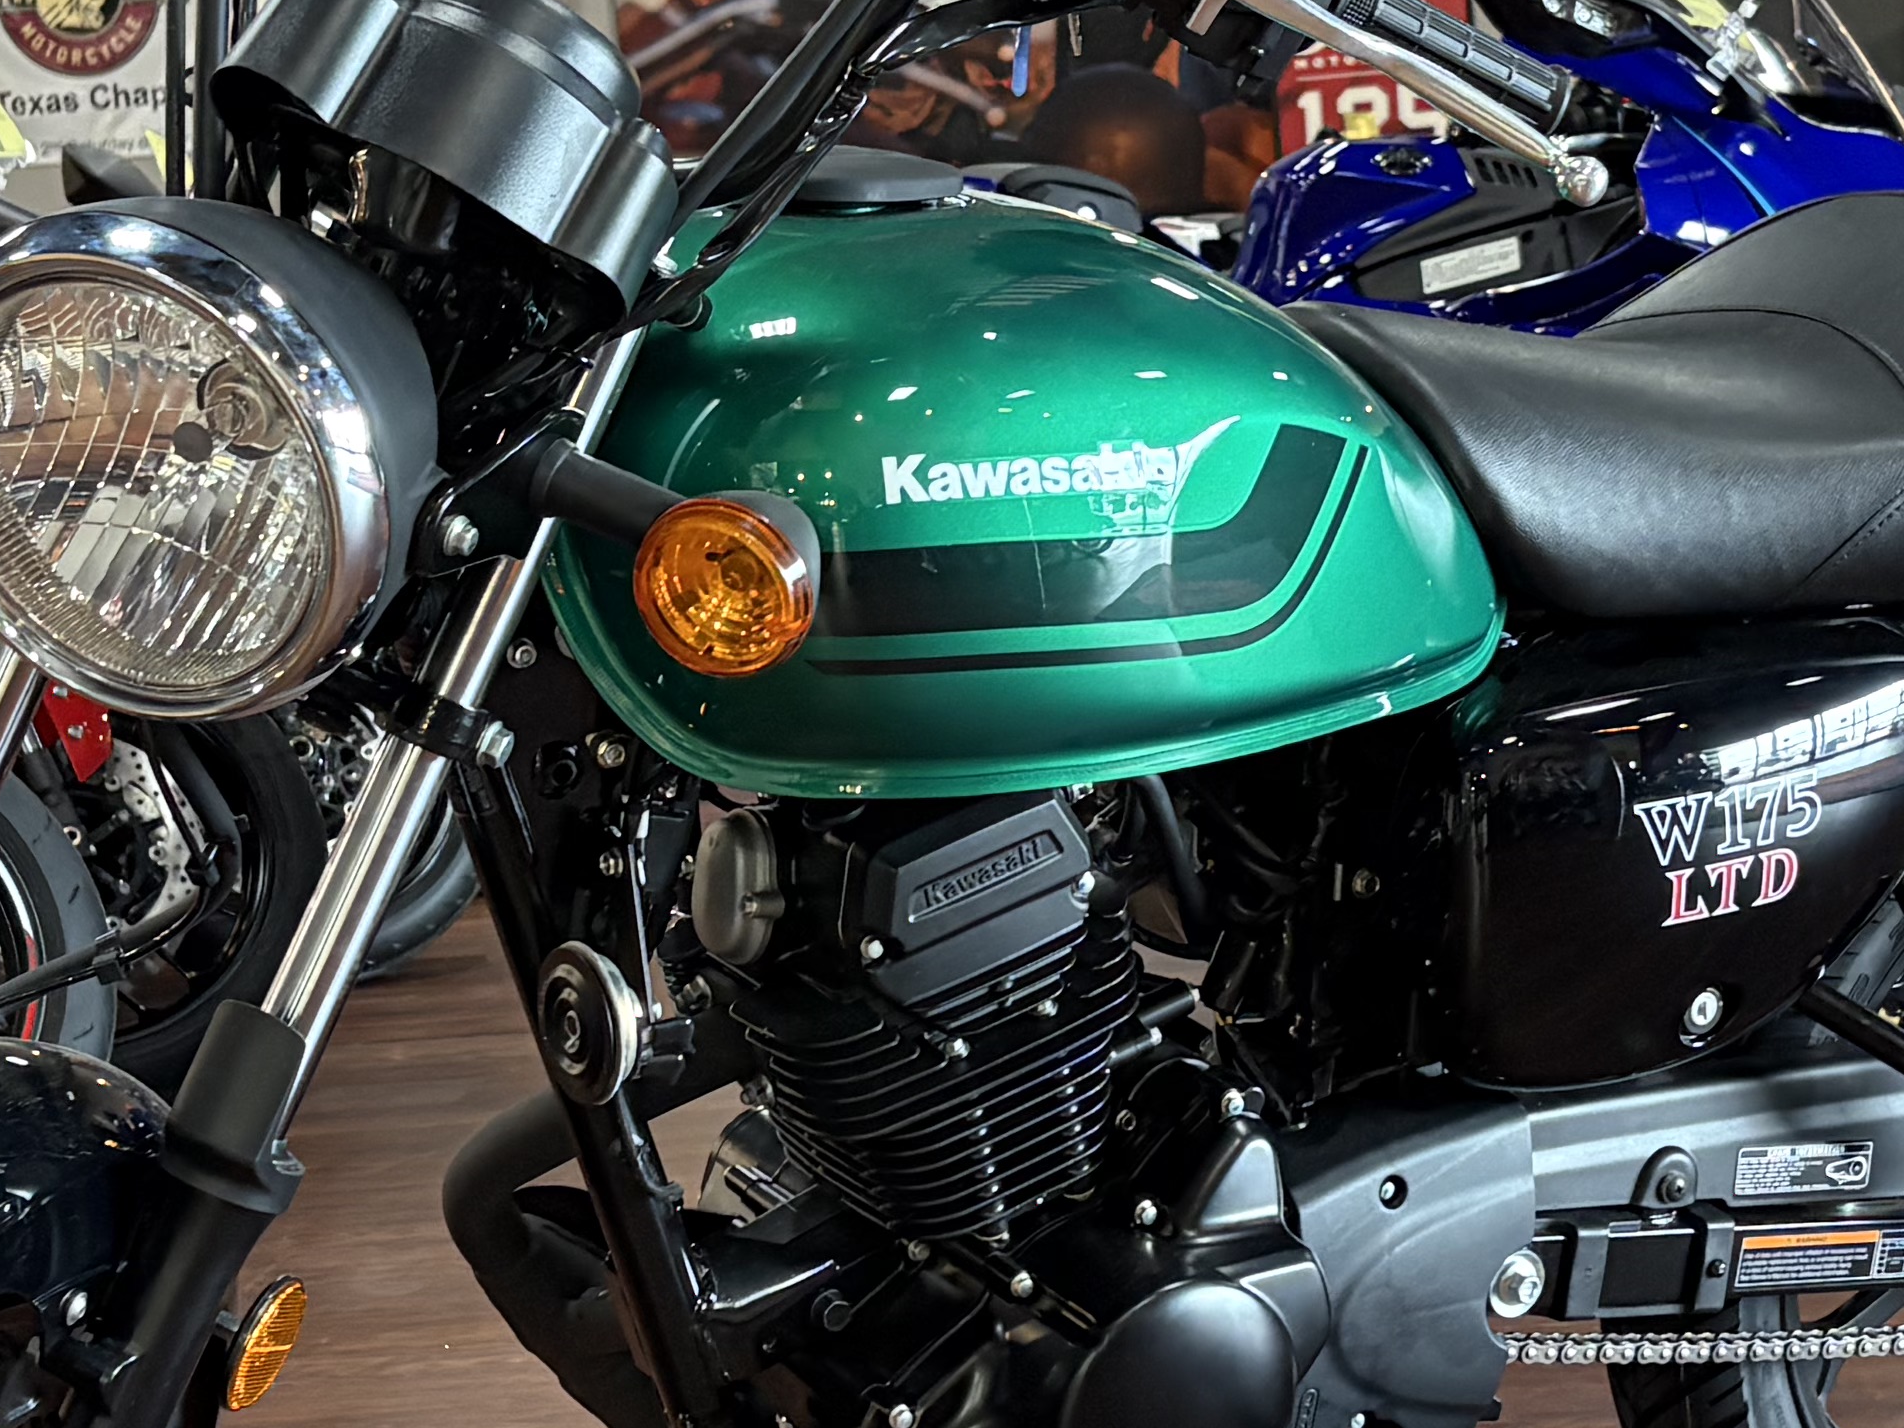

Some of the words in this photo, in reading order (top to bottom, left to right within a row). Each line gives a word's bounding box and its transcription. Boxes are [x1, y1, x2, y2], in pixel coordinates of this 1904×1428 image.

[18, 15, 144, 68] MOTORCYCLE
[89, 82, 167, 111] Chap
[880, 442, 1152, 506] Kawasaki
[1632, 766, 1824, 868] W175
[922, 838, 1045, 910] Kawasaki
[1659, 846, 1801, 929] LTD
